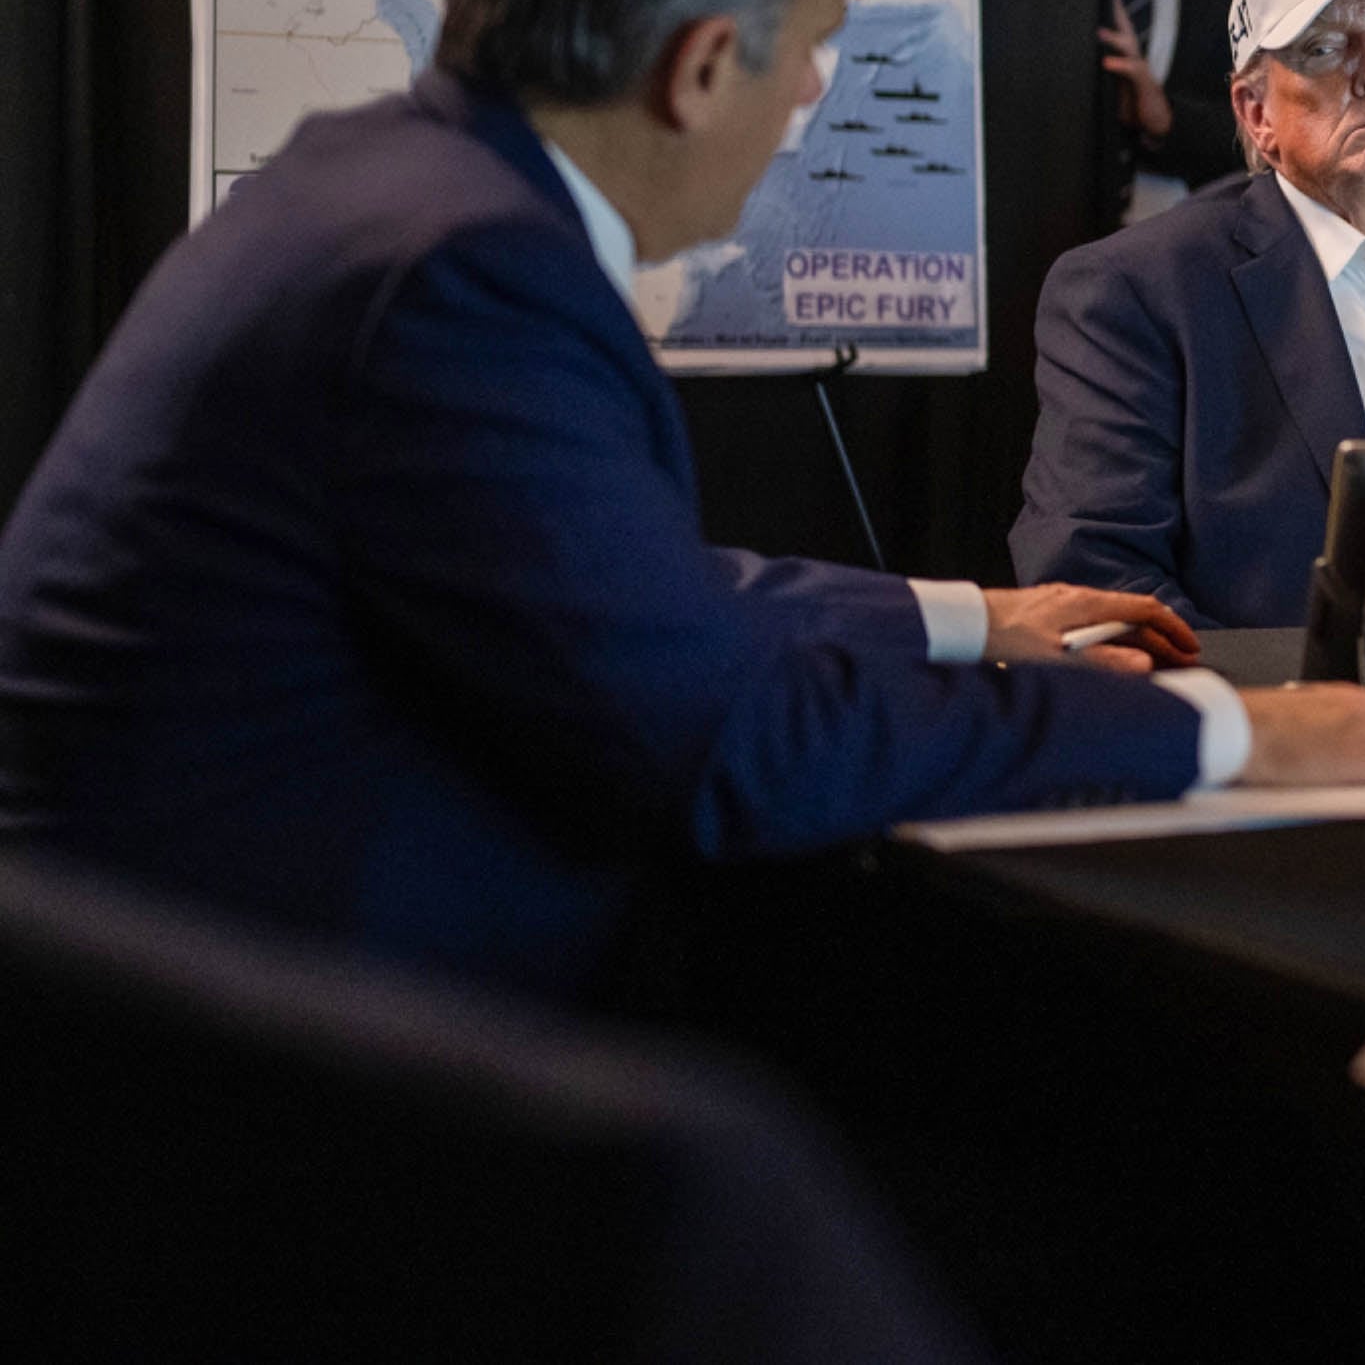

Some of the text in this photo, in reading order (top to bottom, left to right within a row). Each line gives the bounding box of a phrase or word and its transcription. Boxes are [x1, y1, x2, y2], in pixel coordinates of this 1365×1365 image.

[787, 251, 965, 282] OPERATION
[795, 291, 957, 322] EPIC FURY
